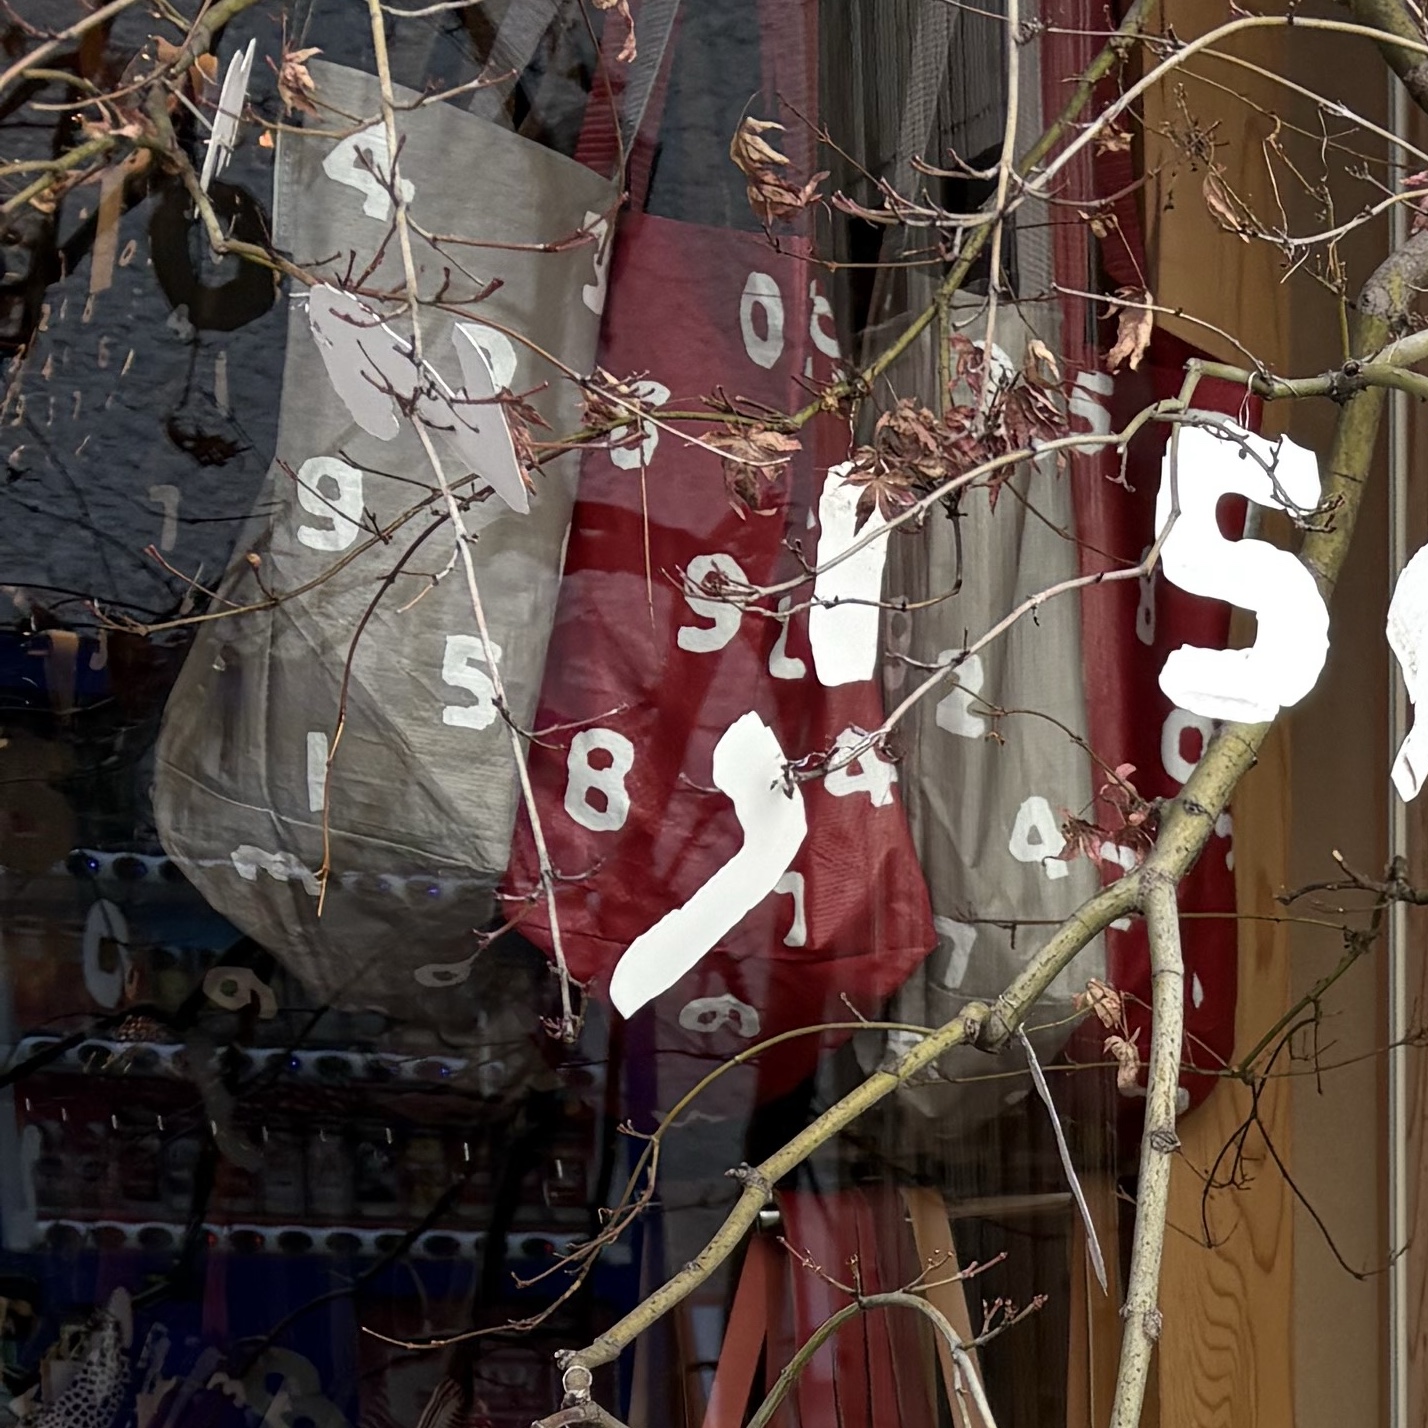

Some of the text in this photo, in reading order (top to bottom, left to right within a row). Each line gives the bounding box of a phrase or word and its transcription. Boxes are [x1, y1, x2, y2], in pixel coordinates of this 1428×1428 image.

[323, 122, 415, 221] 4
[740, 271, 784, 369] 0
[297, 457, 364, 551] 9
[677, 552, 751, 652] 9
[1155, 418, 1330, 723] 5
[442, 635, 503, 730] 5
[936, 649, 985, 739] 2
[565, 728, 635, 831] 8
[824, 727, 899, 807] 4
[1009, 796, 1069, 879] 4
